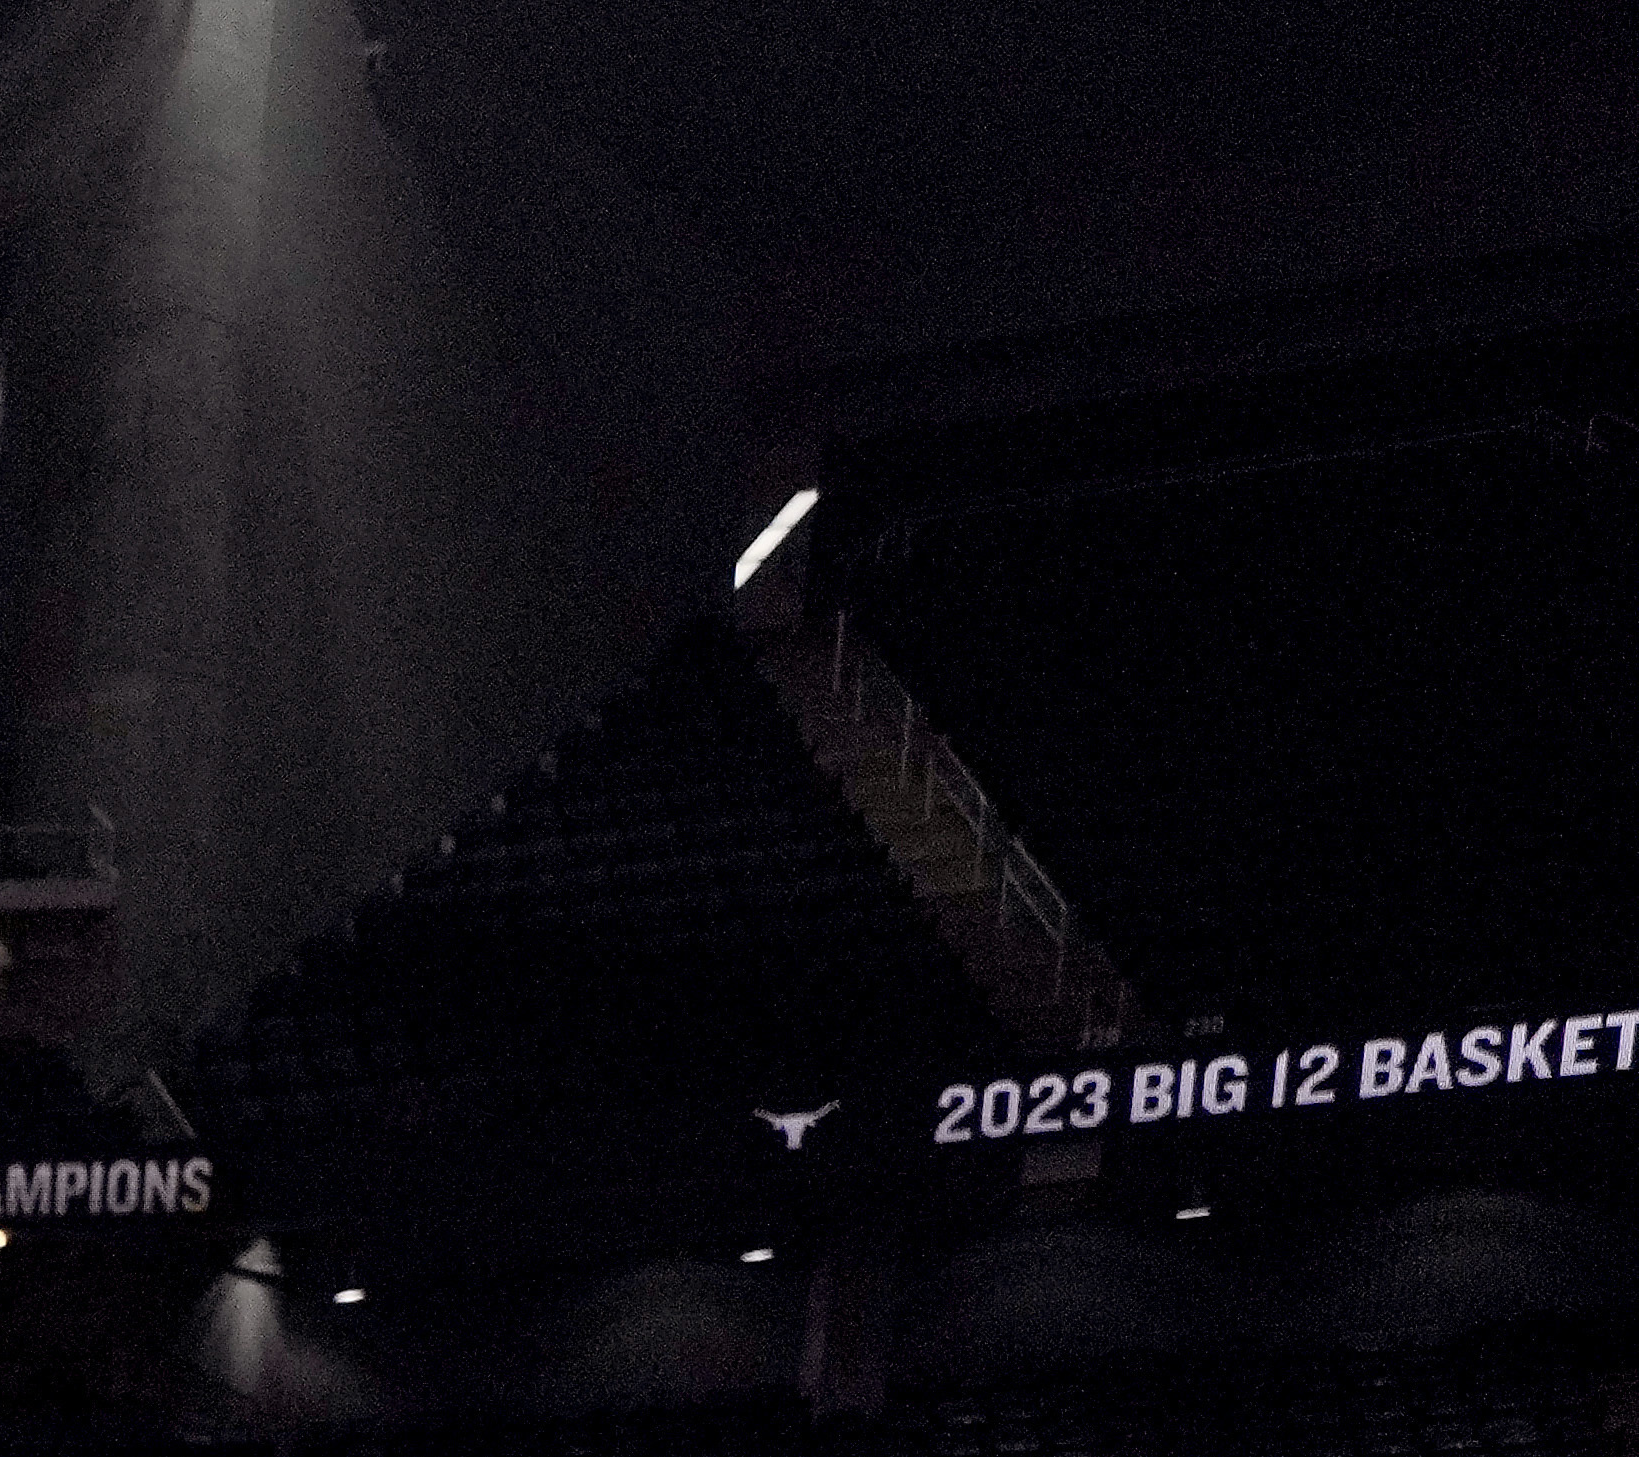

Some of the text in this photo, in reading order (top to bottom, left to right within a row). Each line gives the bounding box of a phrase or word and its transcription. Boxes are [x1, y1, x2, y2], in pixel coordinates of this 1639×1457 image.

[935, 1070, 1111, 1143] 2023
[1130, 1055, 1248, 1123] BIG
[1271, 1045, 1340, 1108] 12
